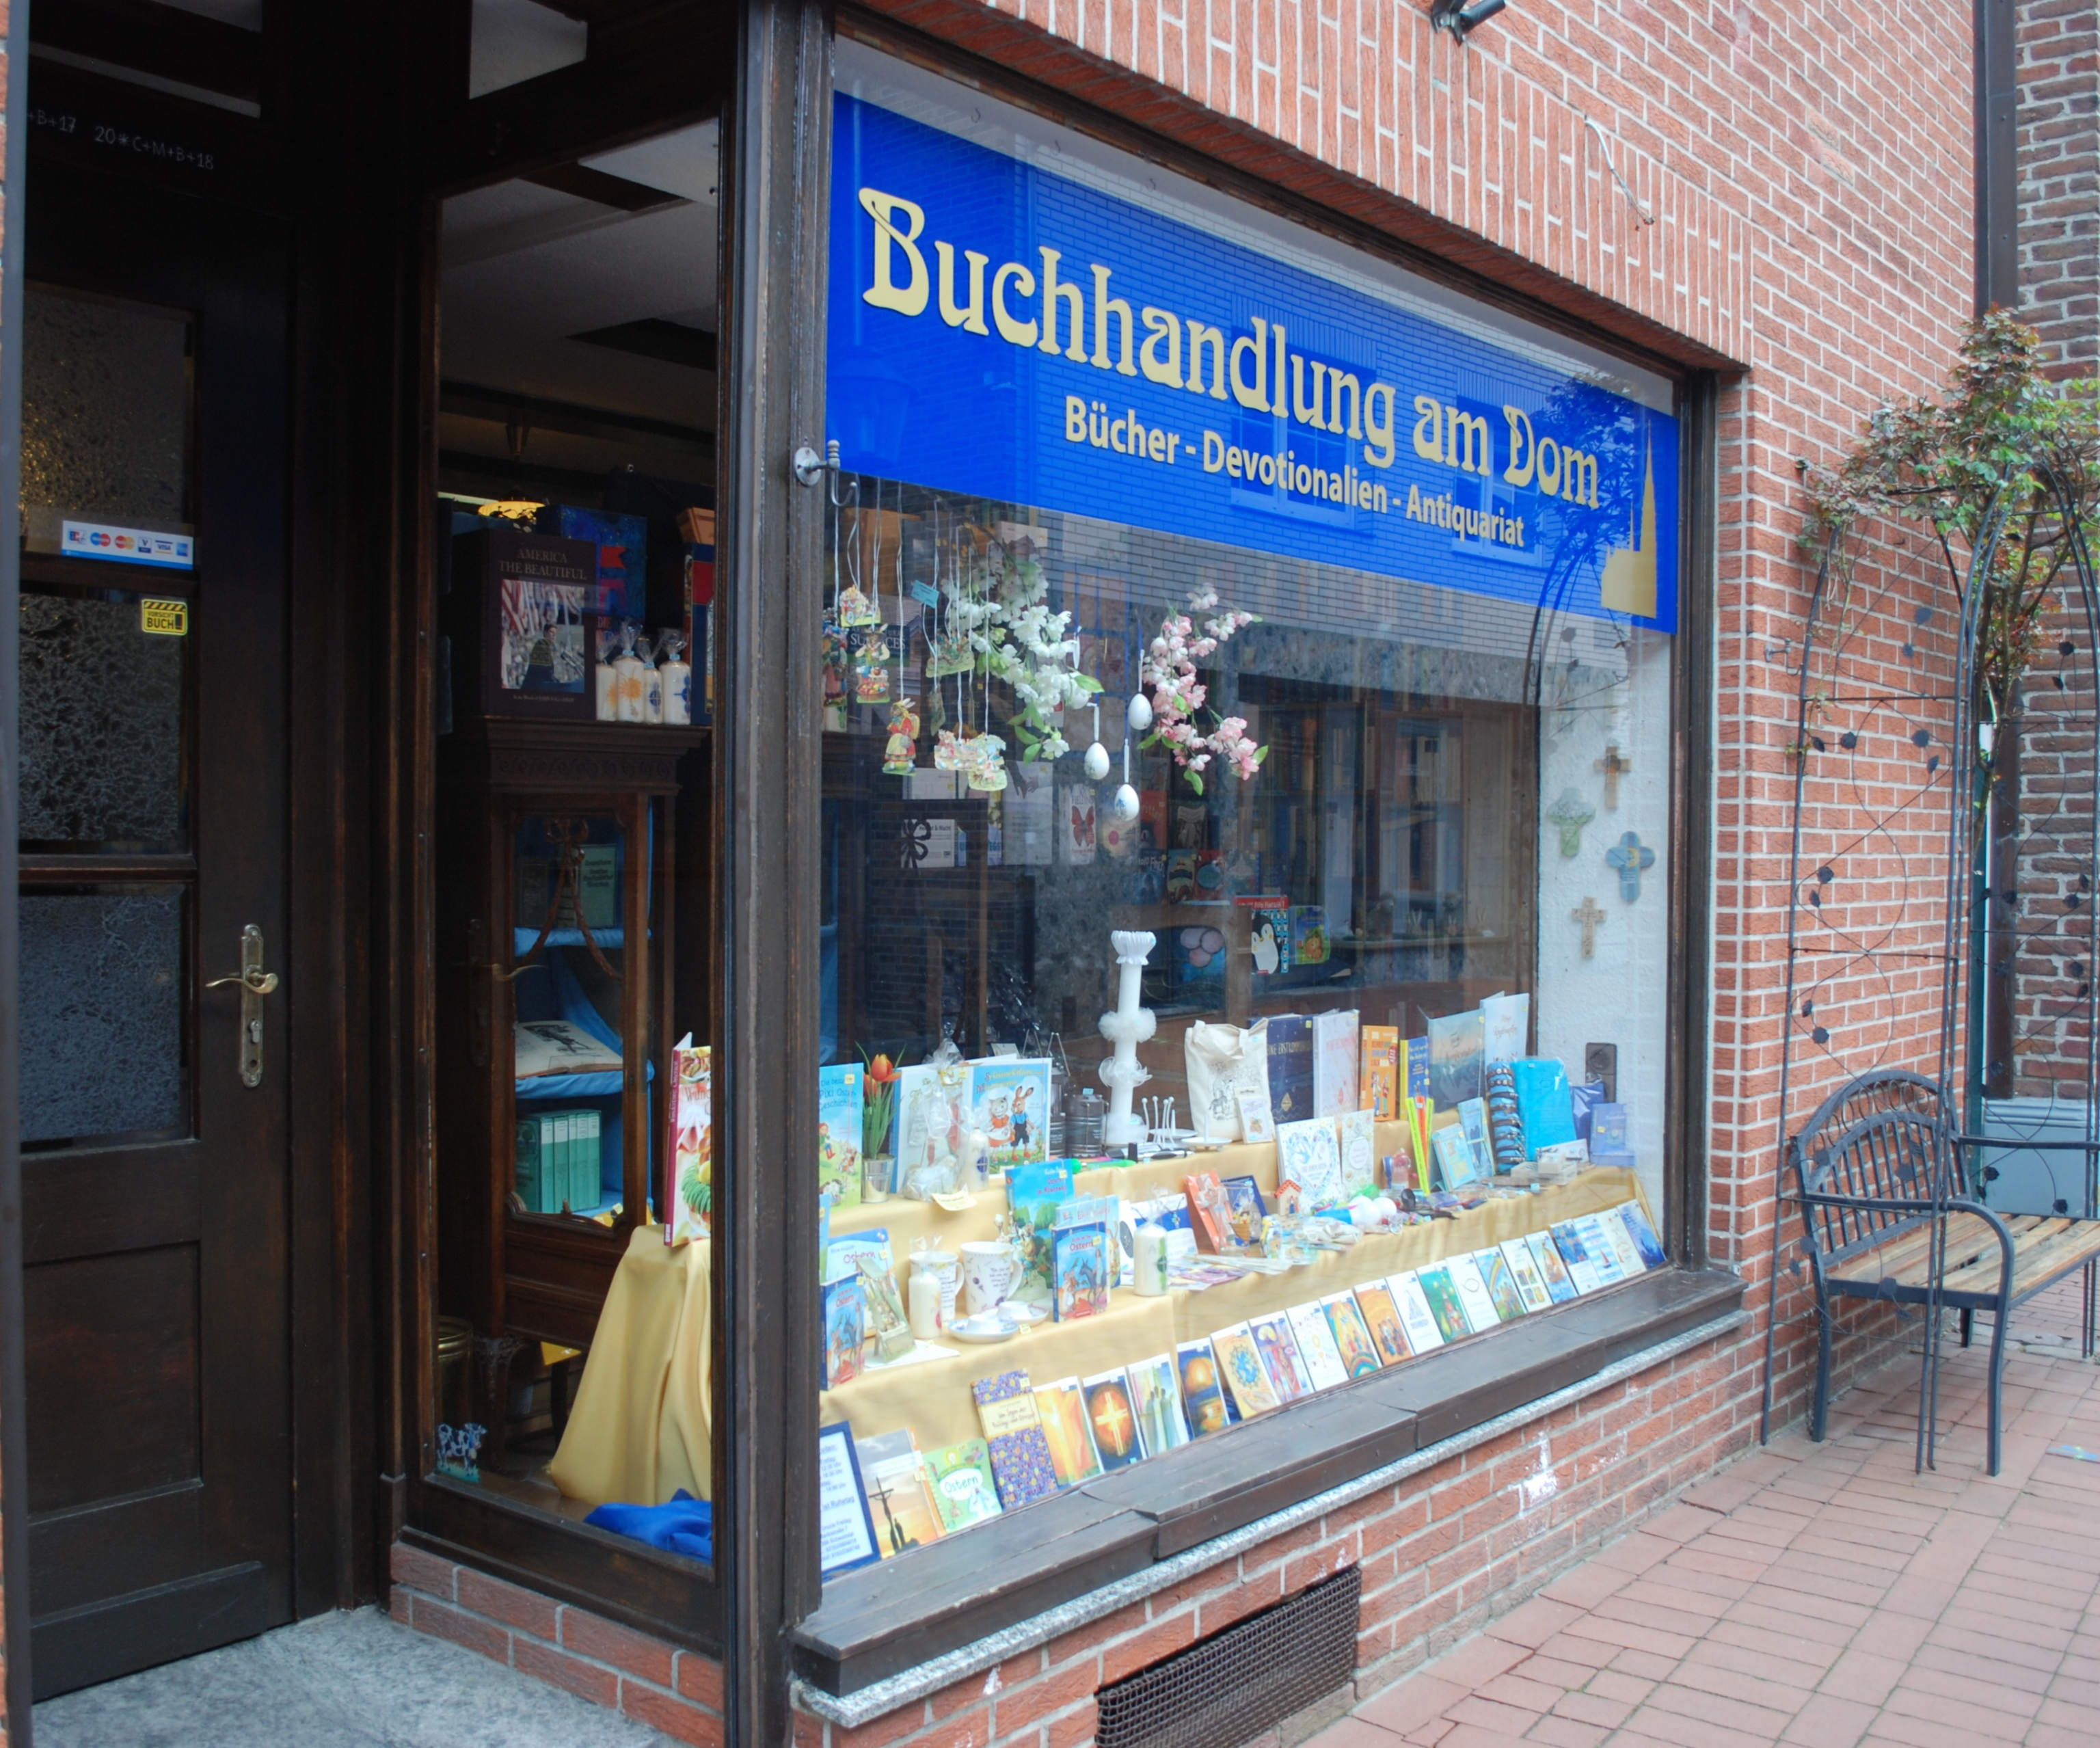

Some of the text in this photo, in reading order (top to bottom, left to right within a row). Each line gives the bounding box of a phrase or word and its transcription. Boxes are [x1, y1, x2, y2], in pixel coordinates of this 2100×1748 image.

[858, 187, 1600, 509] Buchhandlung am Dom
[1066, 395, 1180, 466] Bücher
[1204, 430, 1388, 513] Devotionalien
[1406, 485, 1525, 548] Antiquariat
[517, 549, 567, 563] AMERICA
[499, 561, 587, 580] THE BEAUTIFUL
[147, 617, 174, 629] BUCH
[836, 1088, 857, 1097] Oster-
[1069, 1241, 1094, 1252] Ostern
[835, 1294, 854, 1308] Ostern
[944, 1476, 979, 1493] Ostern
